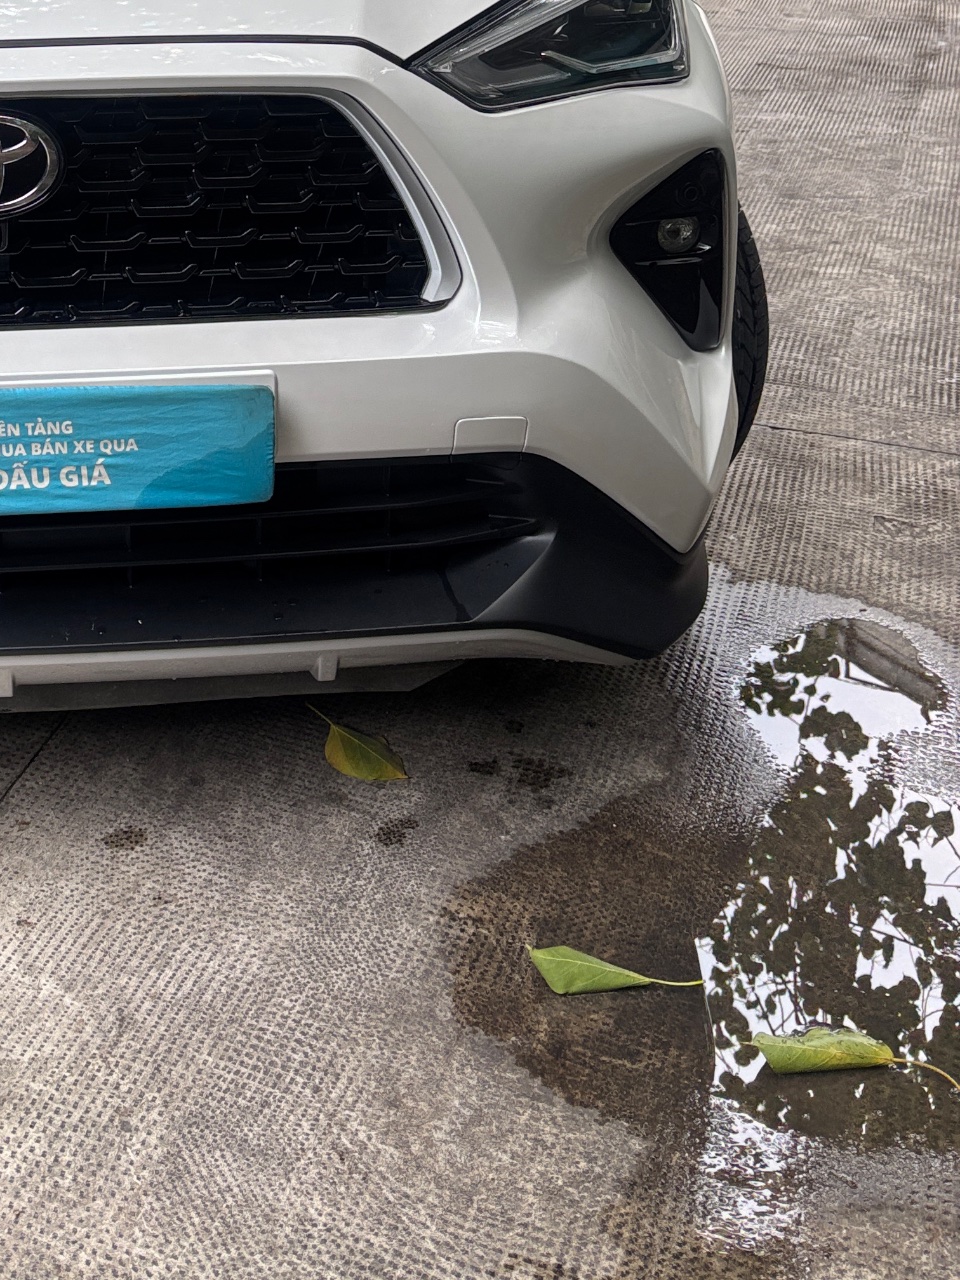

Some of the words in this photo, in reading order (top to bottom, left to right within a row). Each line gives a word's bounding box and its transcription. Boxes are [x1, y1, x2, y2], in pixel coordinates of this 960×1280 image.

[25, 417, 73, 436] TẢNG
[31, 438, 68, 456] BÁN
[73, 440, 95, 453] XE
[99, 438, 139, 455] QUA
[59, 457, 112, 487] GIÁ
